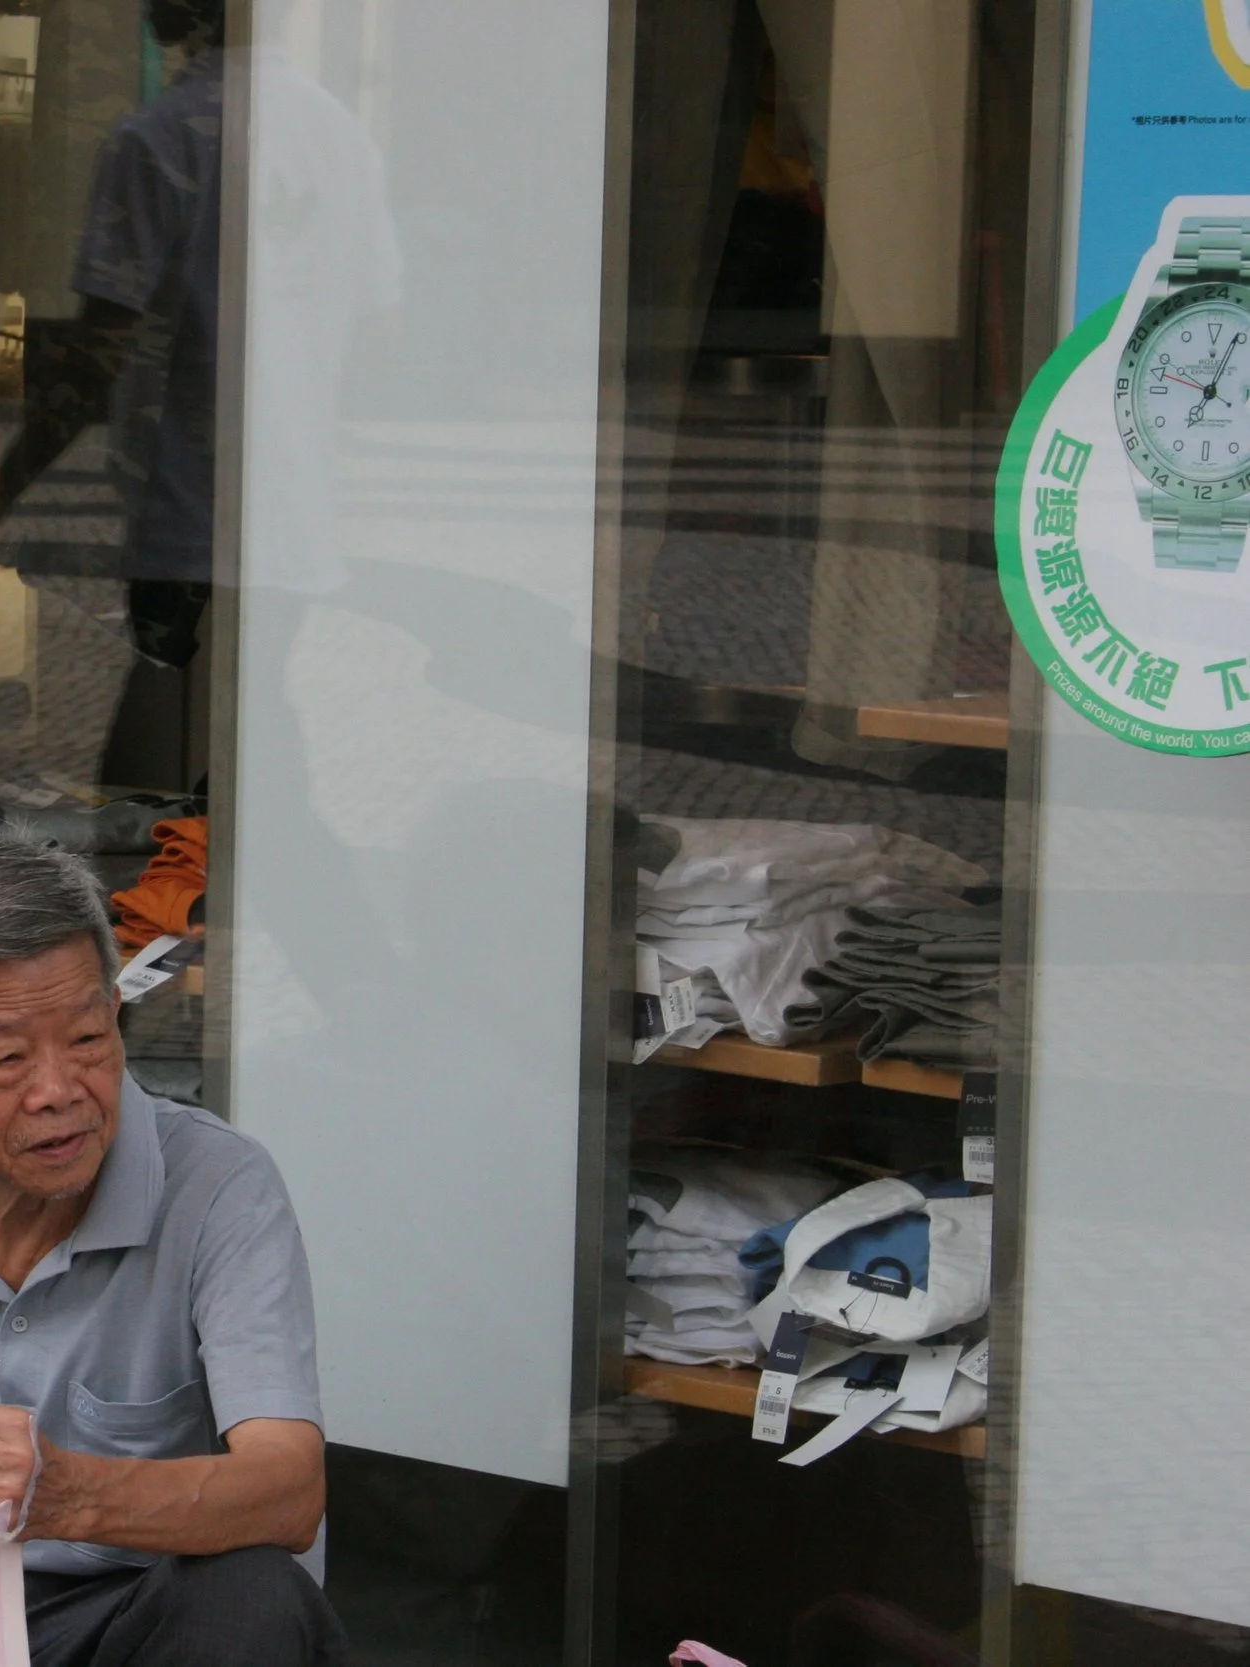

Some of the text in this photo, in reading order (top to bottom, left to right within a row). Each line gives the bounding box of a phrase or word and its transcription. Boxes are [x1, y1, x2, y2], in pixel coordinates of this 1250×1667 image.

[1188, 114, 1246, 124] Photos are for
[1193, 485, 1212, 500] 12
[1047, 660, 1083, 702] Prizes
[1082, 699, 1129, 732] around
[1130, 723, 1152, 742] the
[1155, 733, 1198, 748] world.
[1202, 732, 1230, 748] You
